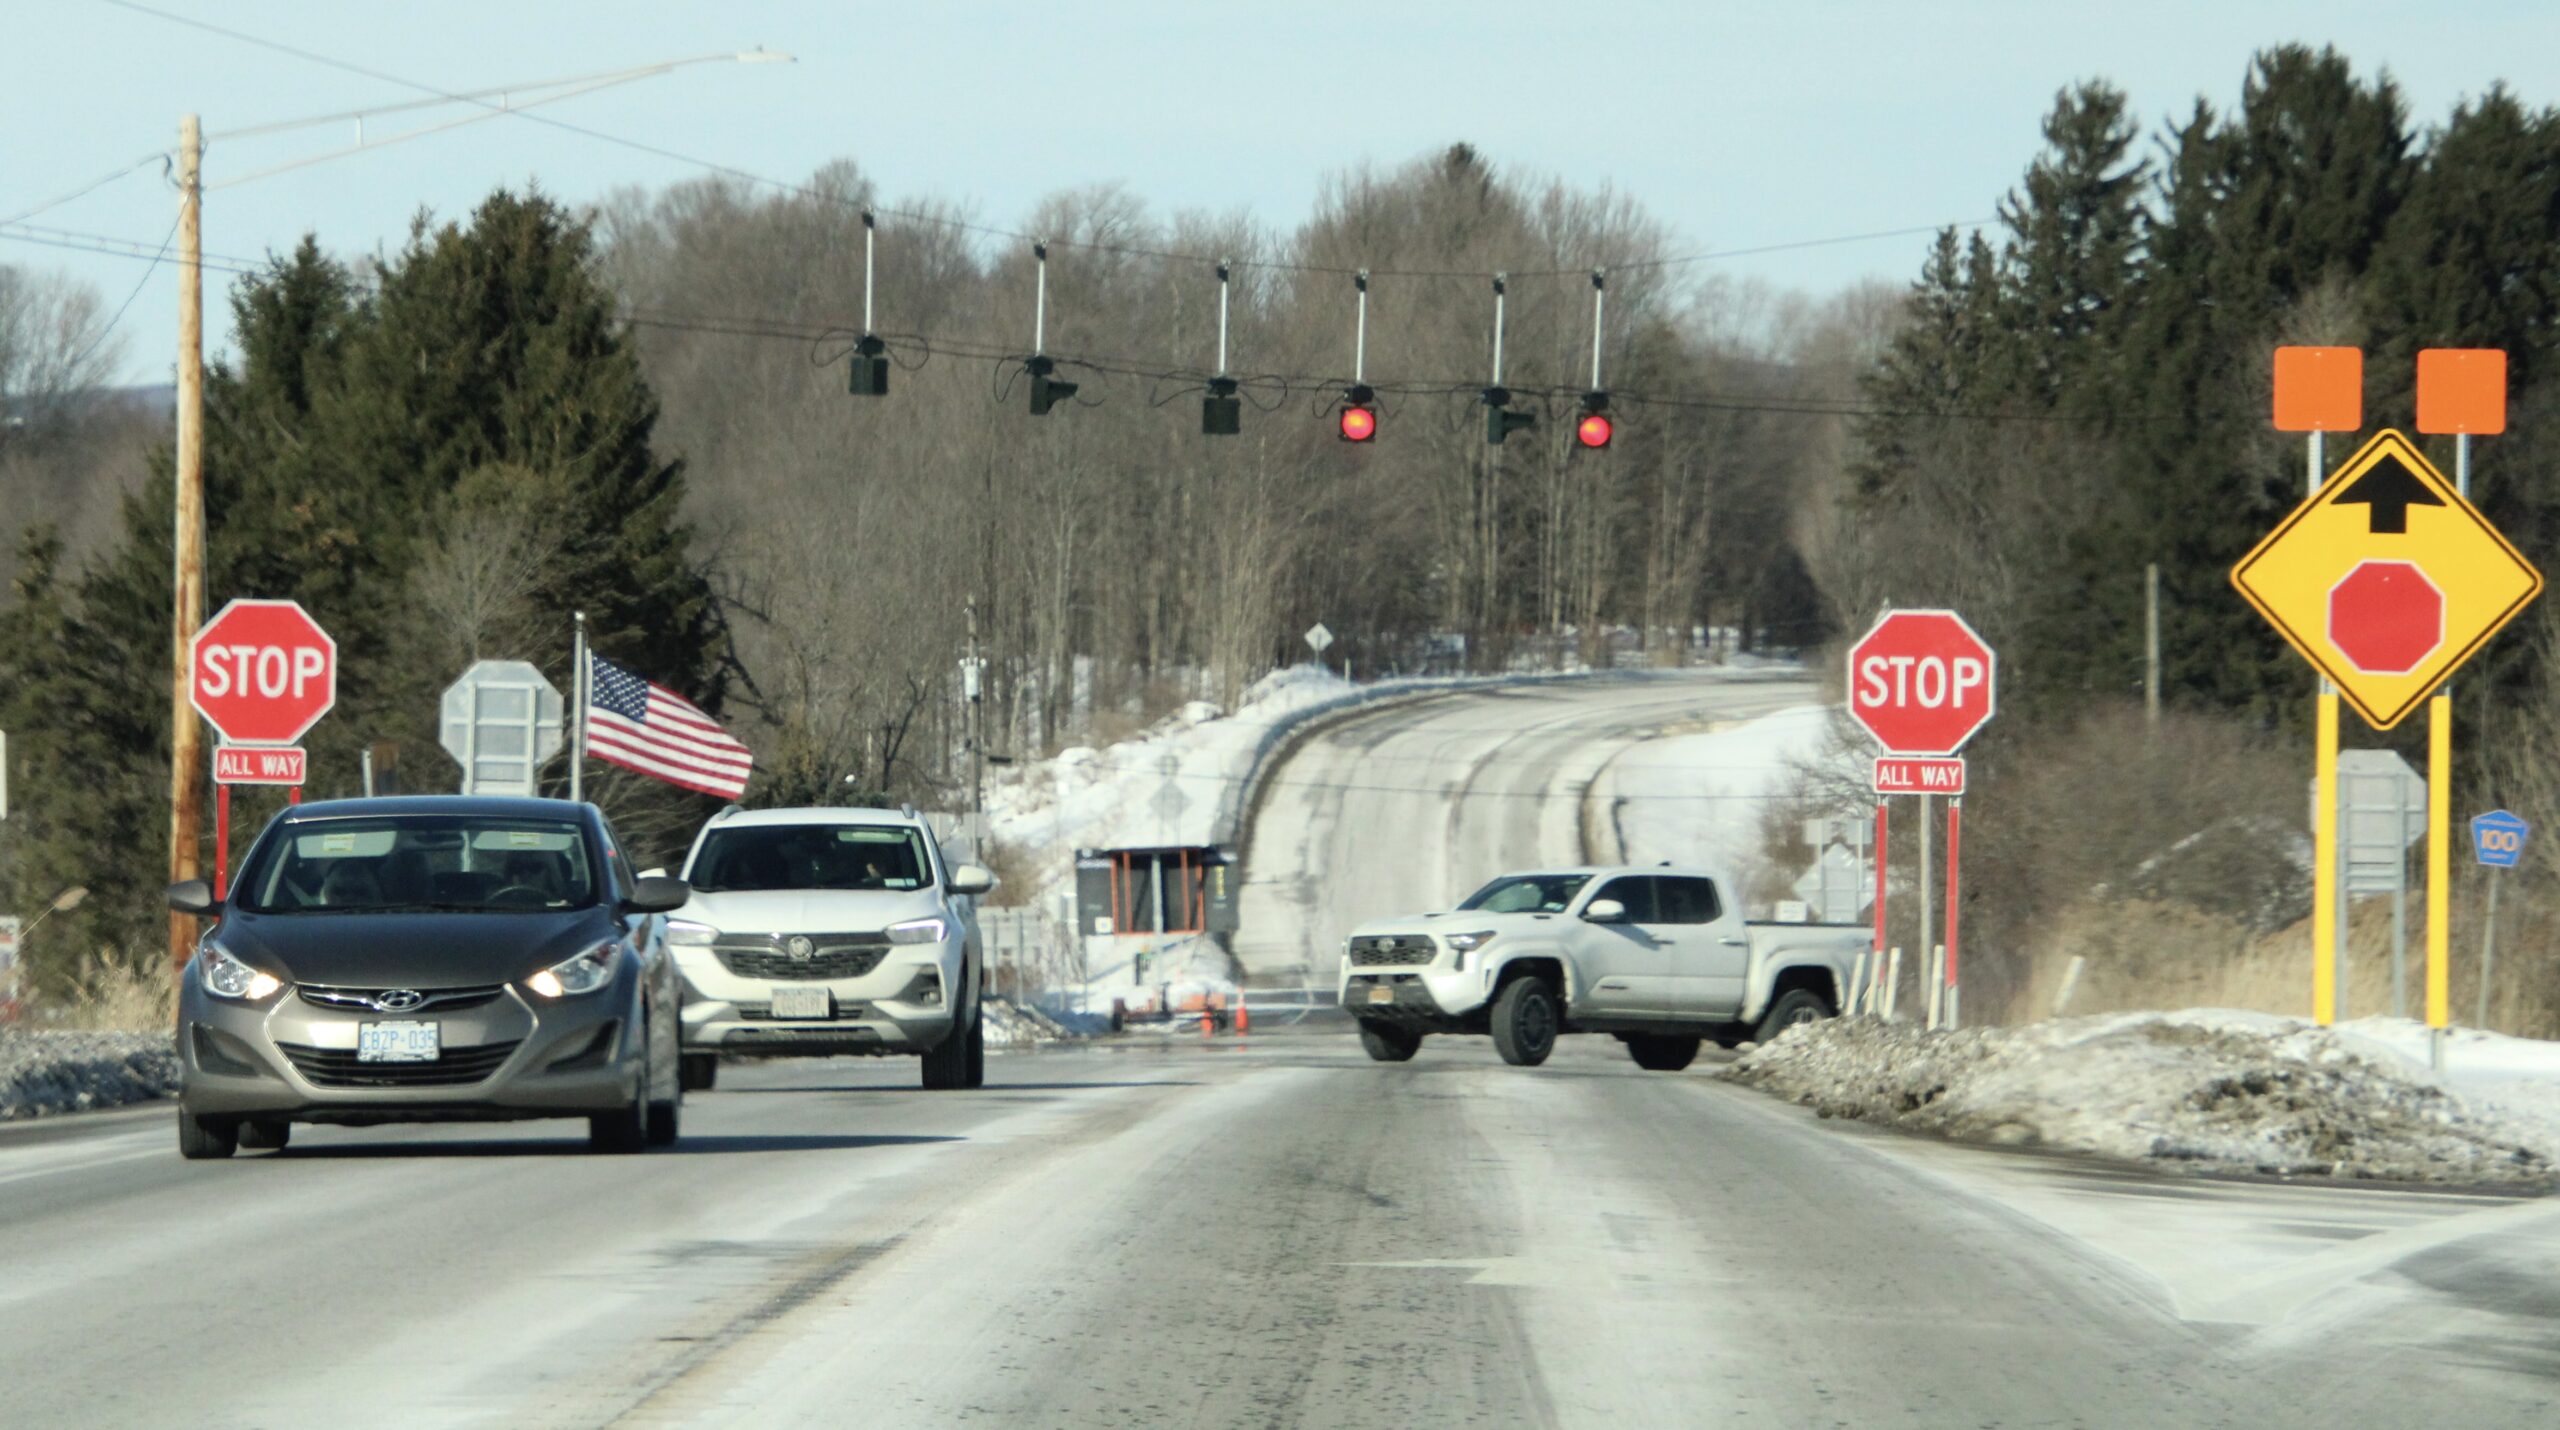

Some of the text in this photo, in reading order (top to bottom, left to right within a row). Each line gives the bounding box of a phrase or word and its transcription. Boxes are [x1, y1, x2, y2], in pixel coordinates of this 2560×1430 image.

[202, 645, 324, 698] STOP
[1860, 656, 1983, 708] STOP
[219, 754, 300, 776] ALL WAY
[1879, 766, 1959, 786] ALL WAY
[2480, 830, 2518, 851] 100
